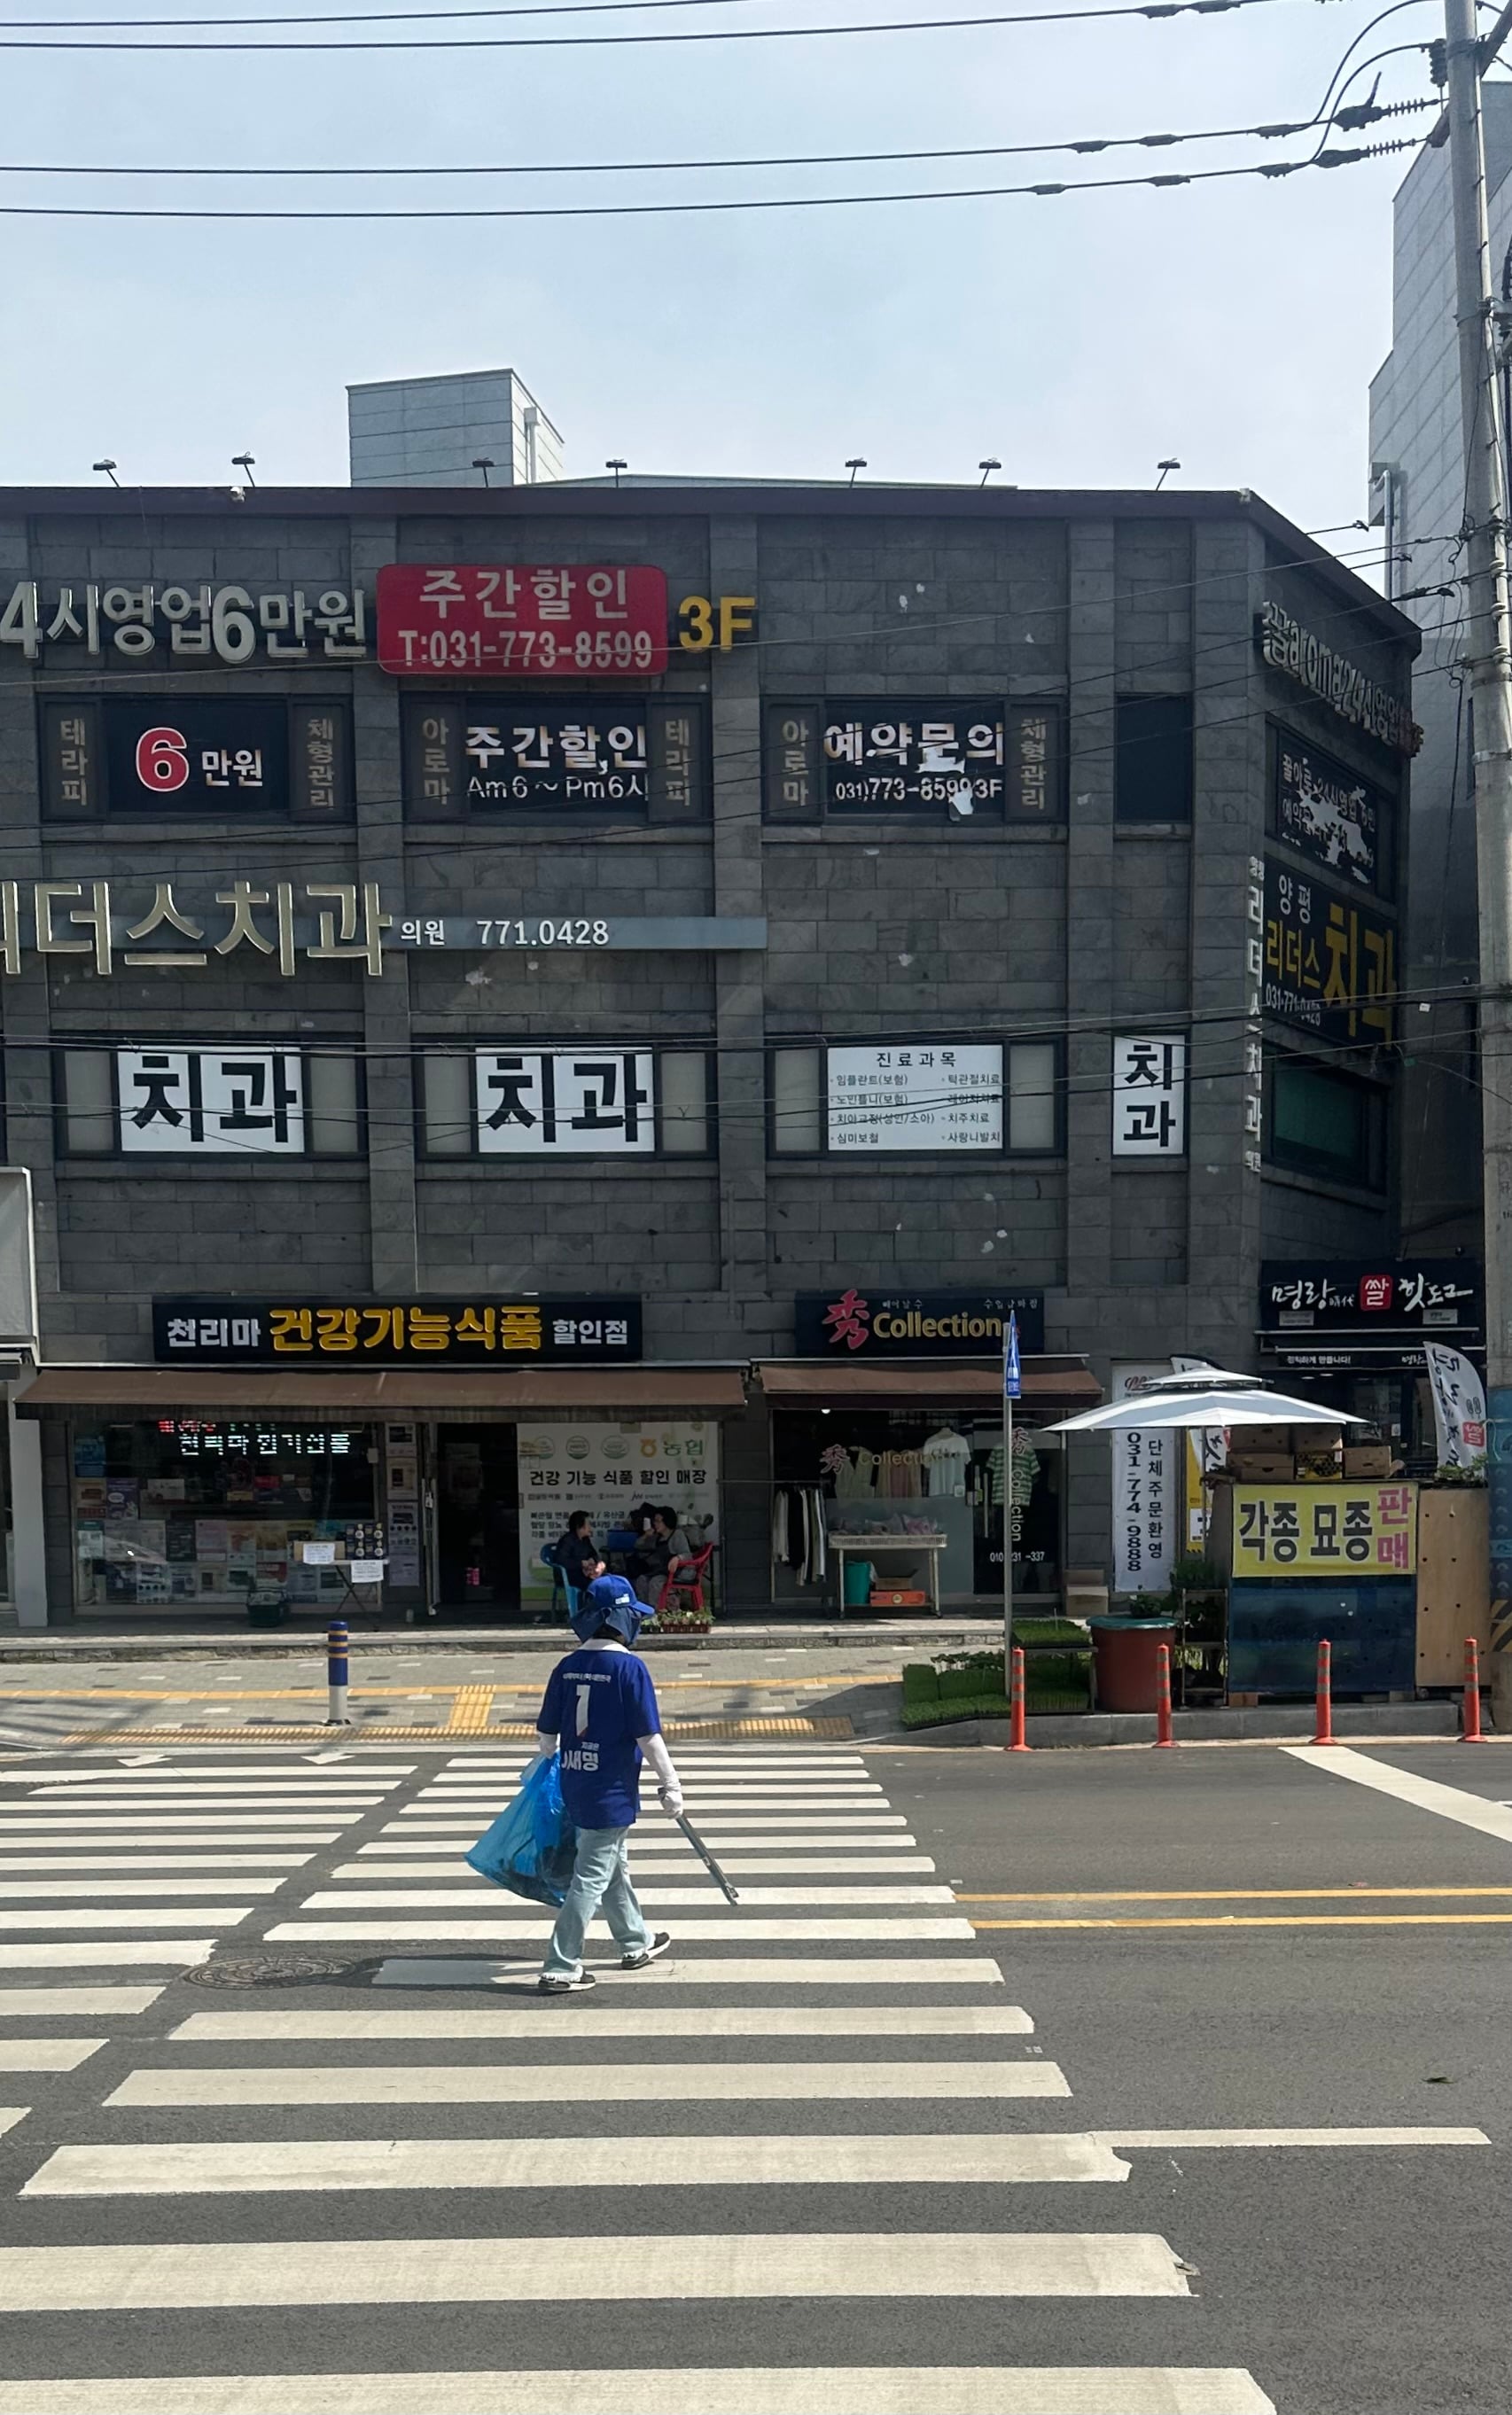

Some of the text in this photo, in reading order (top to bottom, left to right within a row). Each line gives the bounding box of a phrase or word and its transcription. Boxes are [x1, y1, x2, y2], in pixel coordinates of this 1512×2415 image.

[420, 569, 628, 620] 주간할인
[399, 630, 652, 668] T:031-773-8599
[679, 596, 756, 652] 3F
[60, 719, 88, 806] 테라피
[136, 727, 263, 791] 6 만원
[422, 718, 450, 806] 아로마
[464, 725, 648, 770] 주간할인
[665, 719, 690, 806] 테라피
[782, 720, 809, 806] 아로마
[1279, 874, 1312, 924] 양평
[401, 921, 445, 946] 의원
[476, 920, 610, 946] 771.0428
[1266, 902, 1398, 1050] 리더스 치과
[877, 1052, 956, 1067] 진료과목
[947, 1074, 1001, 1086] 턱관절치료
[131, 1055, 297, 1143] 치과
[486, 1054, 648, 1143] 치과
[949, 1113, 989, 1124] 치주치료
[1124, 1044, 1176, 1148] 치과
[838, 1133, 878, 1144] 심미보철
[947, 1133, 1001, 1143] 사랑니발치
[168, 1306, 628, 1350] 천리마 건강기능식품 할인점
[873, 1312, 1002, 1338] Collection
[530, 1469, 706, 1485] 건강 기능 식품 할인 매장
[1126, 1431, 1142, 1572] 031-774-9888
[1239, 1487, 1413, 1570] 각종 묘종 판매
